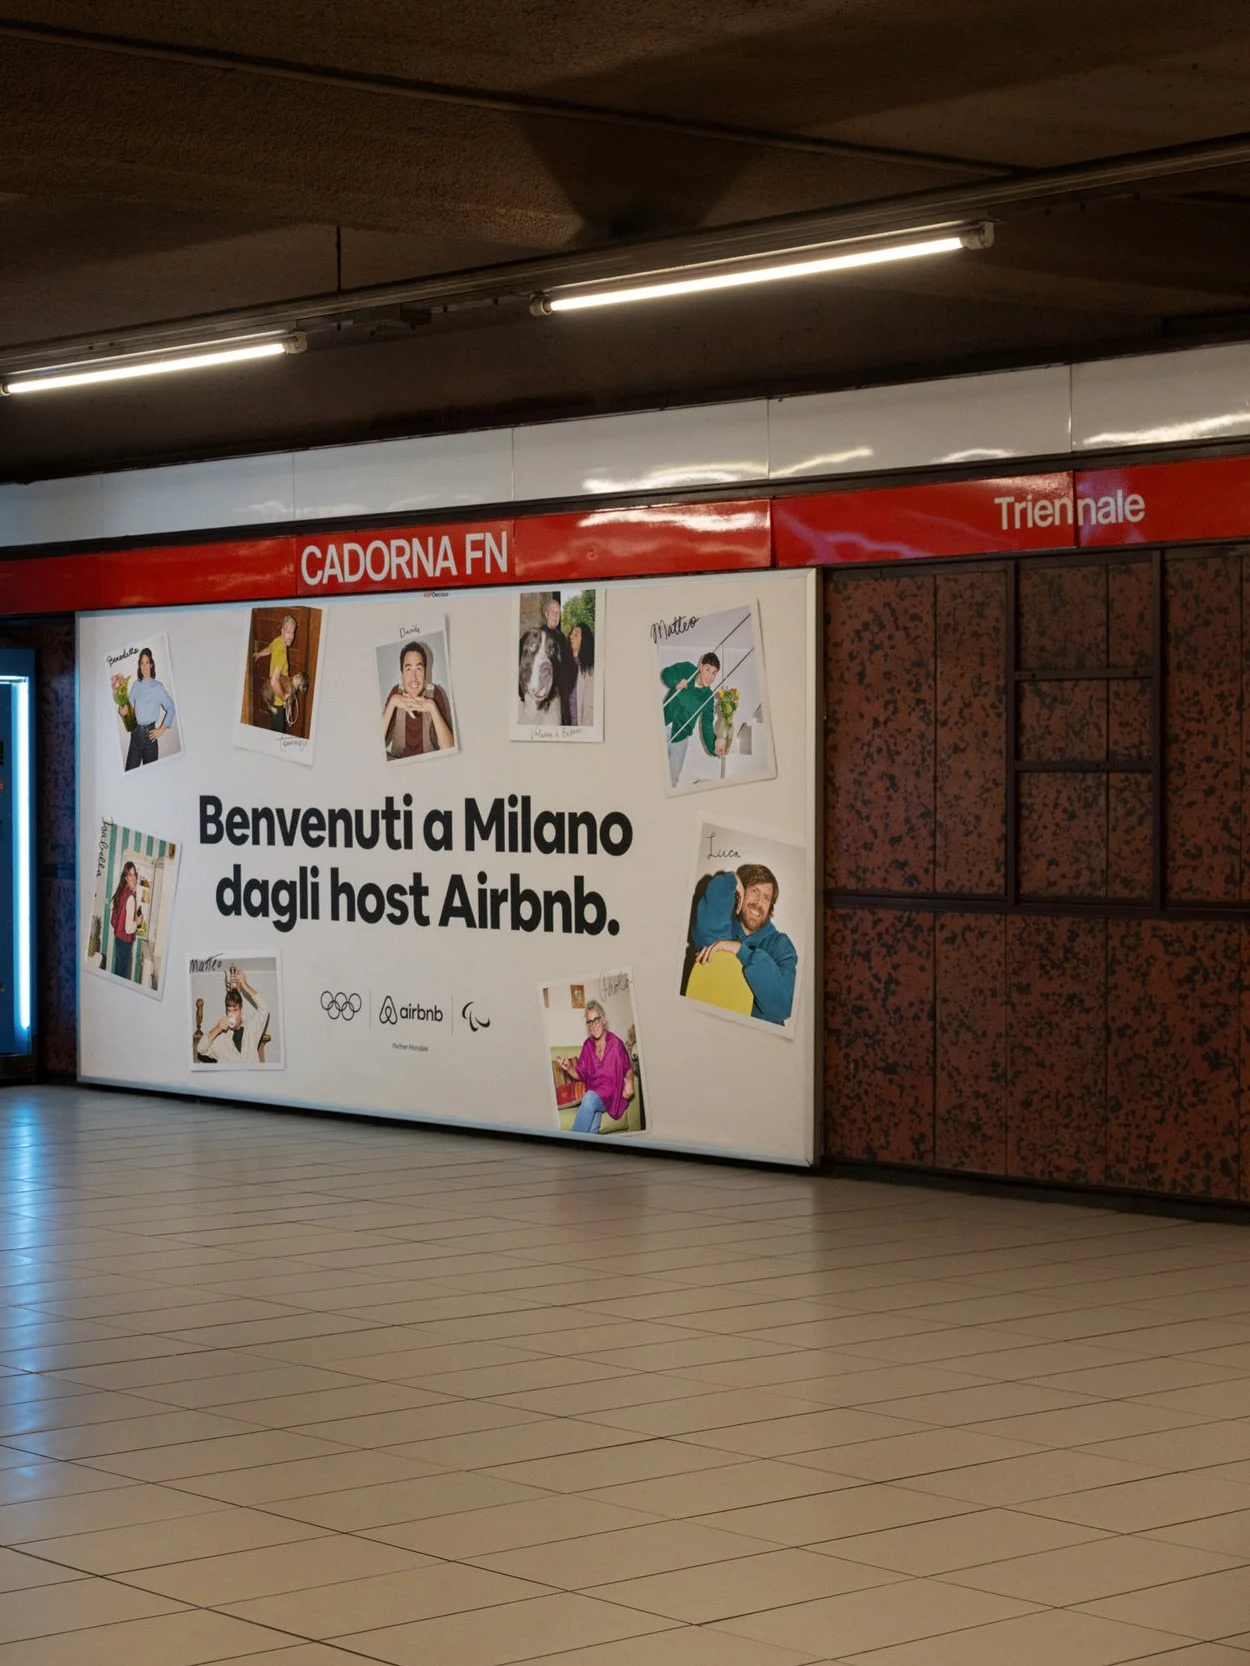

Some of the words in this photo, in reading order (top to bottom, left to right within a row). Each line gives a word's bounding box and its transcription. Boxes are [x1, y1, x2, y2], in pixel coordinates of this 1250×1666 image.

[994, 489, 1145, 530] Triennale
[301, 535, 457, 586] CADORNA
[465, 531, 508, 575] FN
[650, 616, 700, 644] Matteo
[199, 793, 413, 850] Benvenuti
[423, 809, 453, 851] a
[464, 793, 633, 856] Milano
[706, 832, 741, 860] Luca
[216, 863, 320, 933] dagli
[330, 867, 431, 927] host
[438, 870, 620, 936] Airbnb.
[400, 1003, 444, 1022] airbnb
